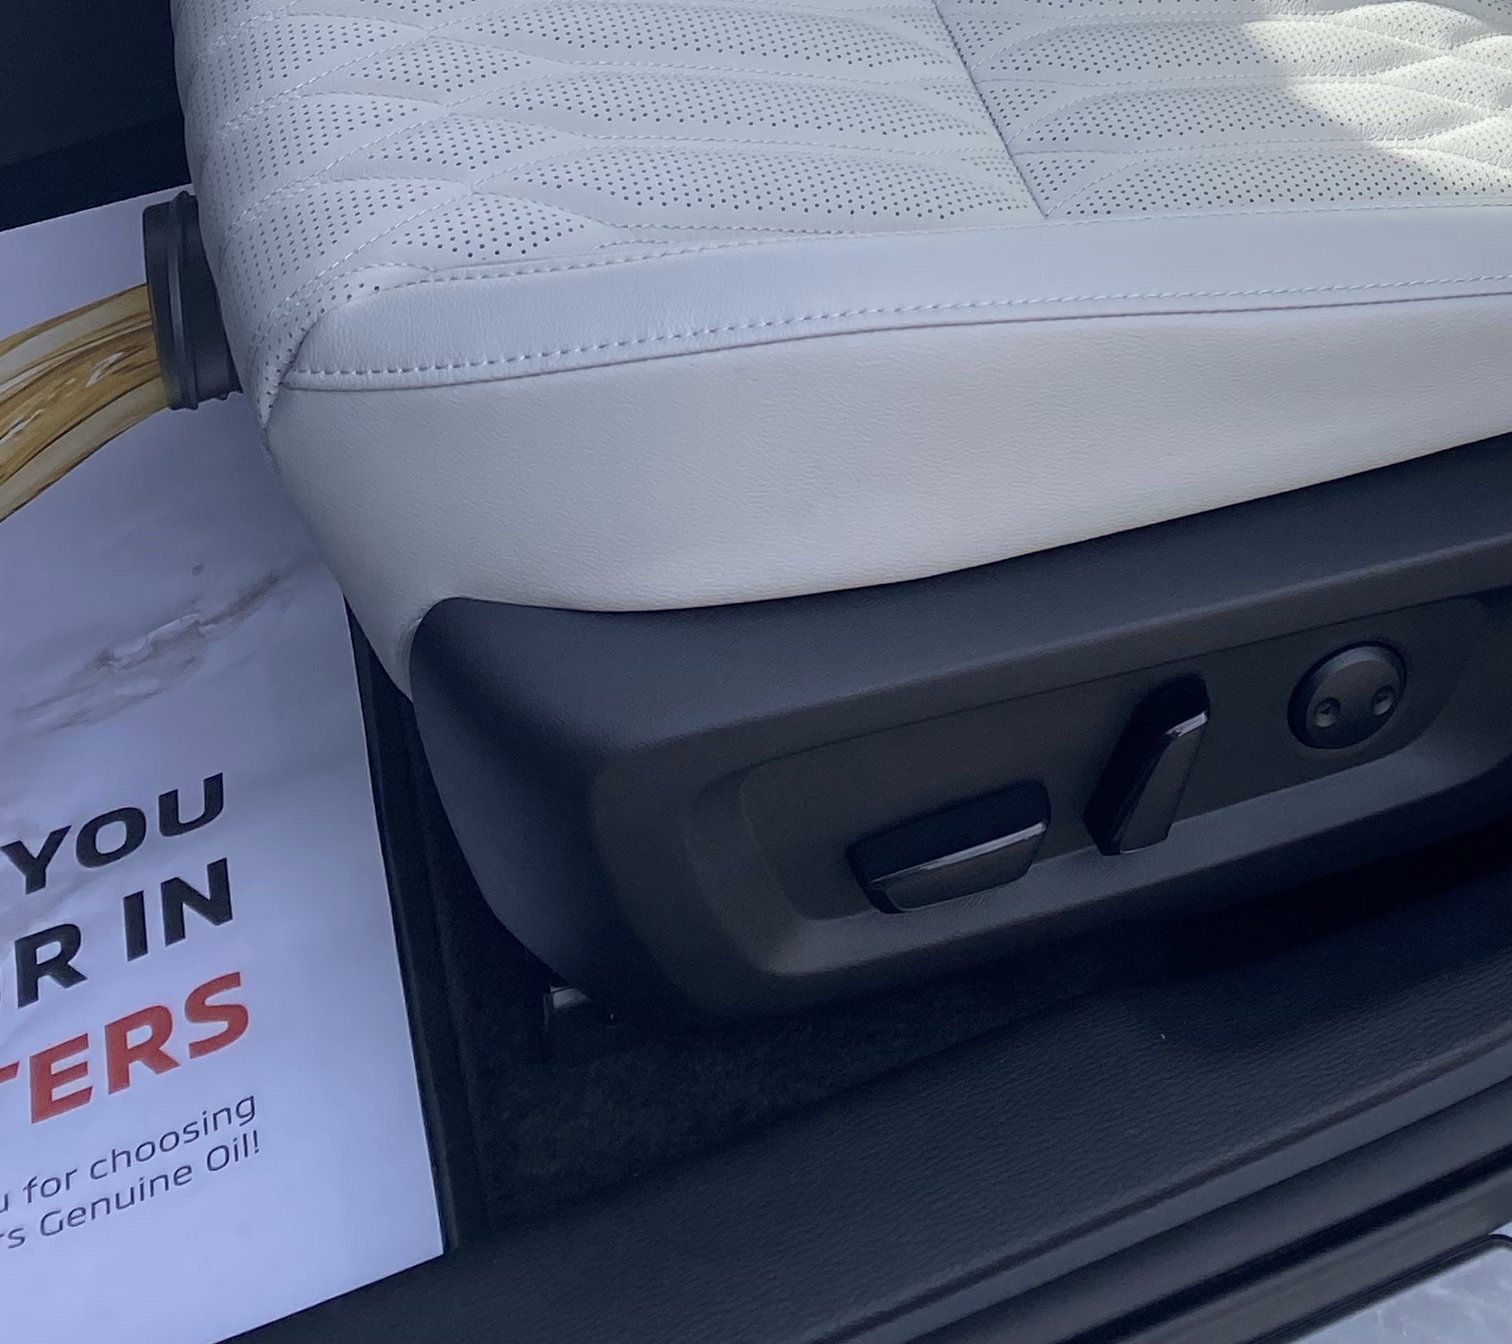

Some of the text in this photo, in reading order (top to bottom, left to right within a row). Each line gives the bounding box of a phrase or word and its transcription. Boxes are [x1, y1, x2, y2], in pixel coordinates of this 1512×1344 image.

[1, 772, 224, 895] YOU
[123, 857, 233, 962] IN
[23, 1168, 78, 1204] for
[90, 1095, 256, 1180] choosing
[40, 1164, 193, 1237] Genuine
[206, 1129, 260, 1172] Oil!
